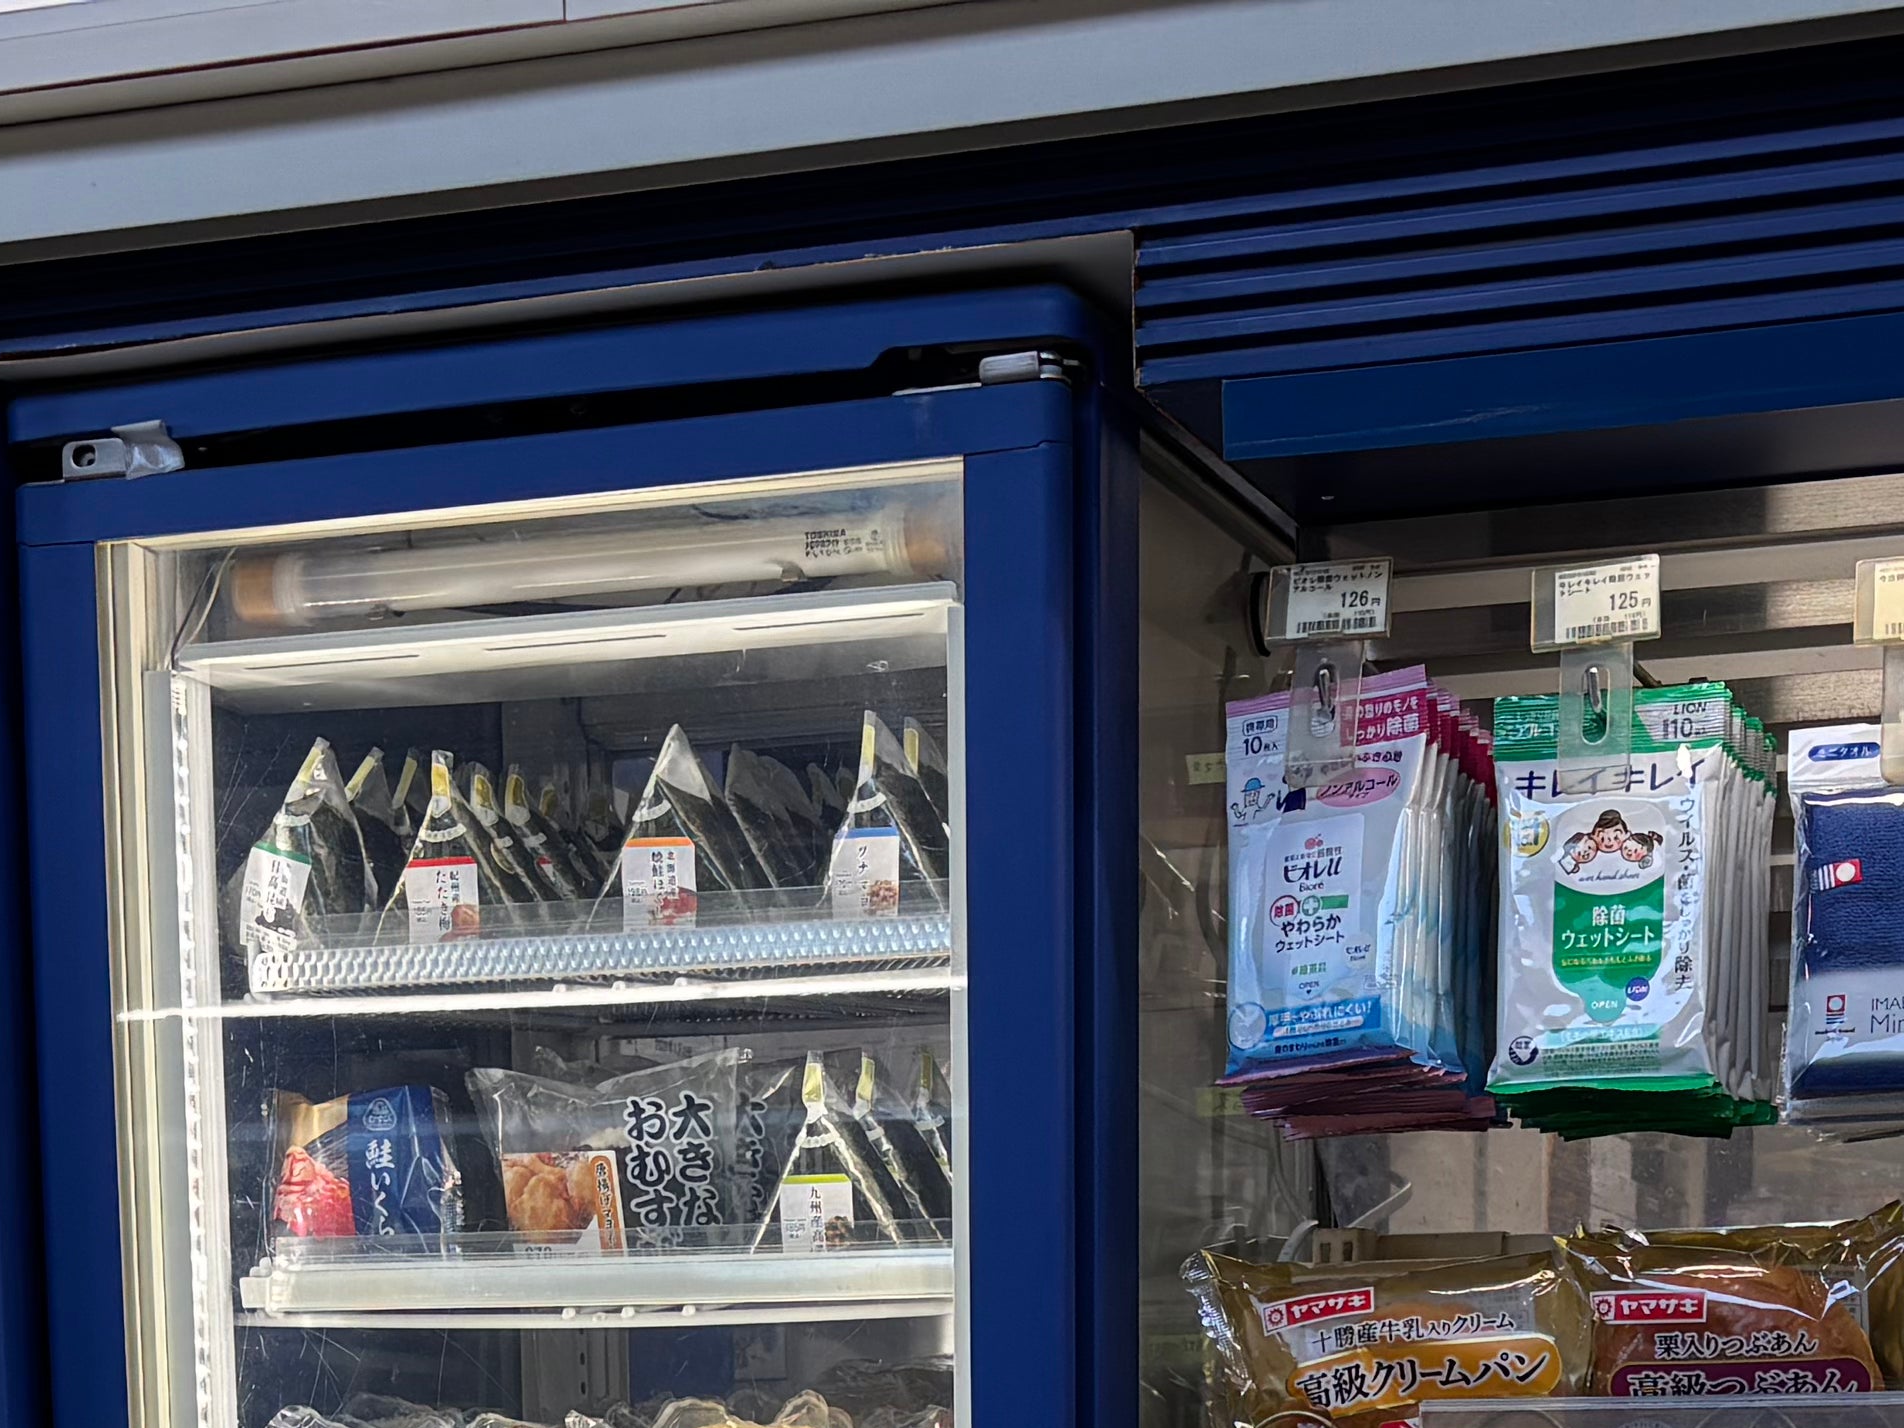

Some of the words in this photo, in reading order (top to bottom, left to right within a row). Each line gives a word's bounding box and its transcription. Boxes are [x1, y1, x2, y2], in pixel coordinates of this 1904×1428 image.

[1673, 703, 1707, 715] LION
[1279, 914, 1342, 937] やわらか
[1592, 905, 1626, 927] 除菌
[1274, 932, 1346, 953] ウェットシート
[1560, 927, 1656, 950] ウェットシート
[672, 1093, 724, 1228] 大きな
[1311, 1312, 1516, 1353] 十勝産牛乳入りクリーム
[1655, 1332, 1818, 1359] 栗入りつぶあん
[1295, 1346, 1551, 1407] 高級クリームパン
